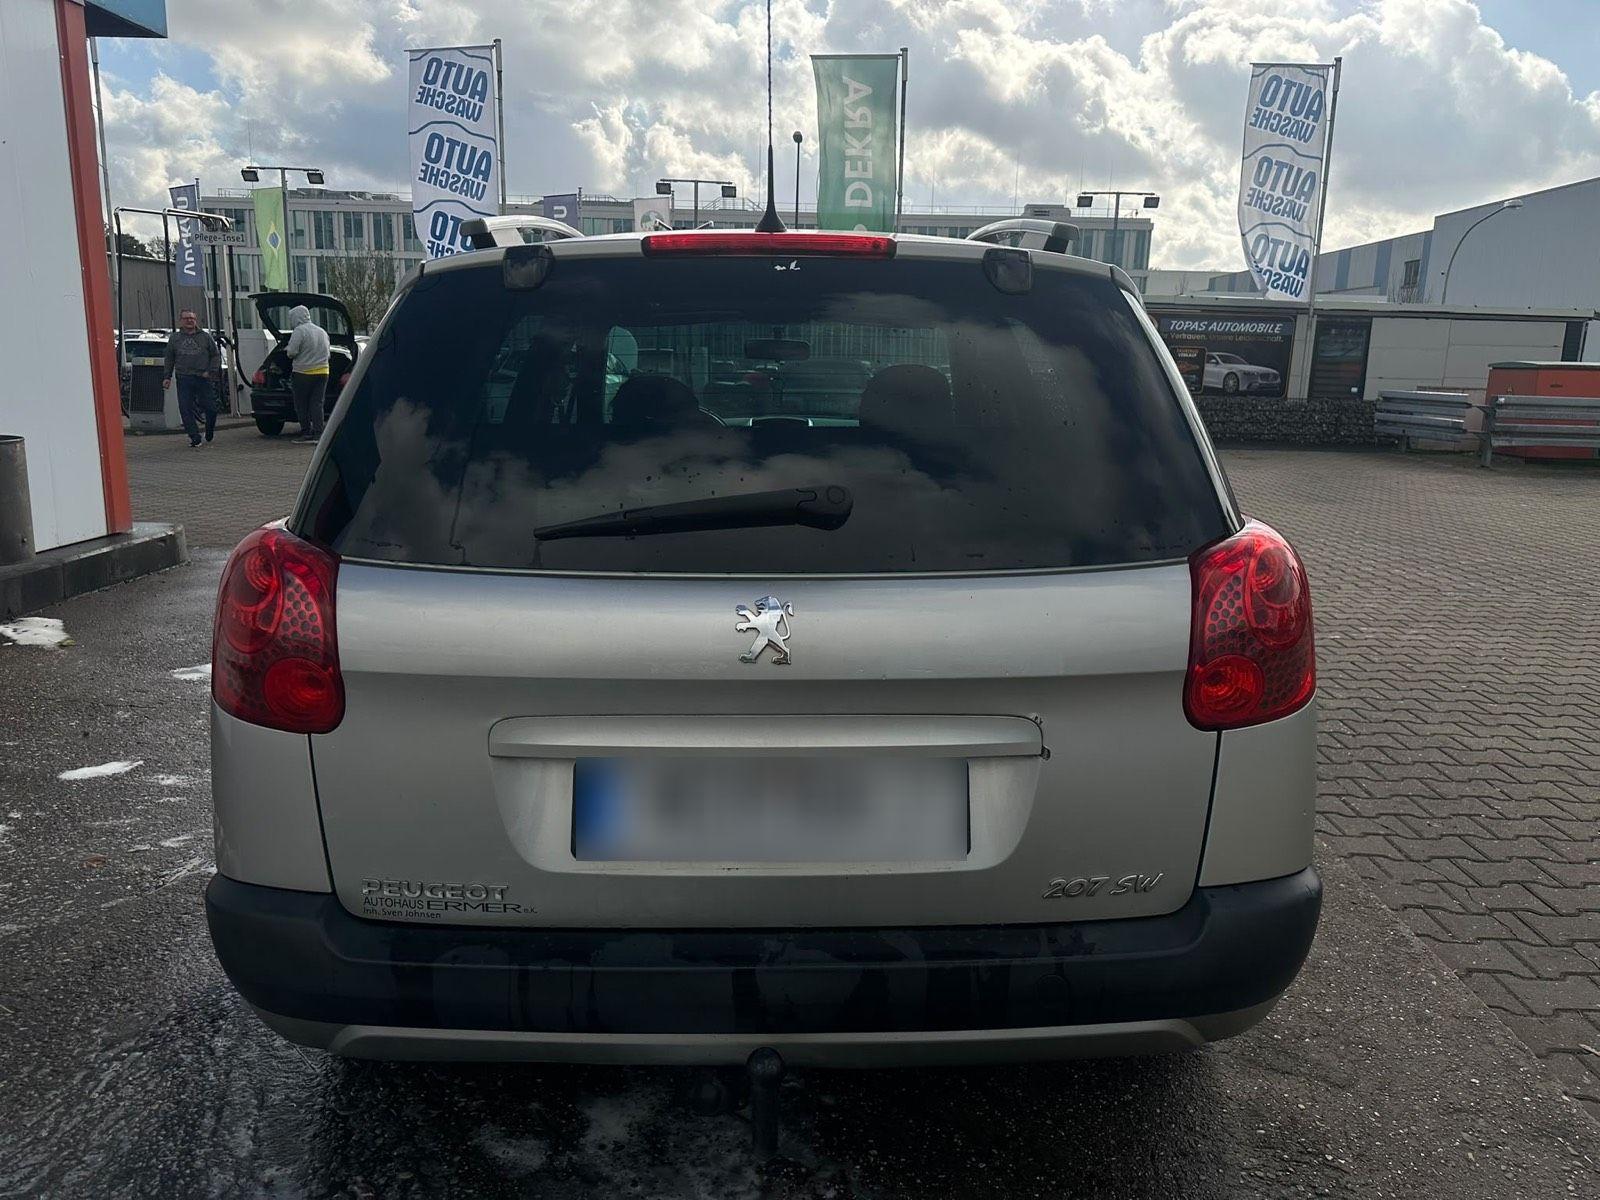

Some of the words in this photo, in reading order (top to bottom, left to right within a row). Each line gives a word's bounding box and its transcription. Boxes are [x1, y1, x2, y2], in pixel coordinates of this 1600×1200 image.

[194, 233, 244, 243] Pflege-Insel
[1169, 320, 1208, 331] TOPAS
[1208, 321, 1284, 333] AUTOMOBILE
[362, 878, 509, 900] PEUGEOT
[1042, 876, 1110, 899] 207
[1110, 873, 1164, 896] SW
[363, 897, 424, 909] AUTOHAUS
[427, 900, 522, 913] ERMER
[363, 908, 380, 916] Inh.
[382, 909, 403, 917] Sven
[405, 909, 441, 919] Johnsen
